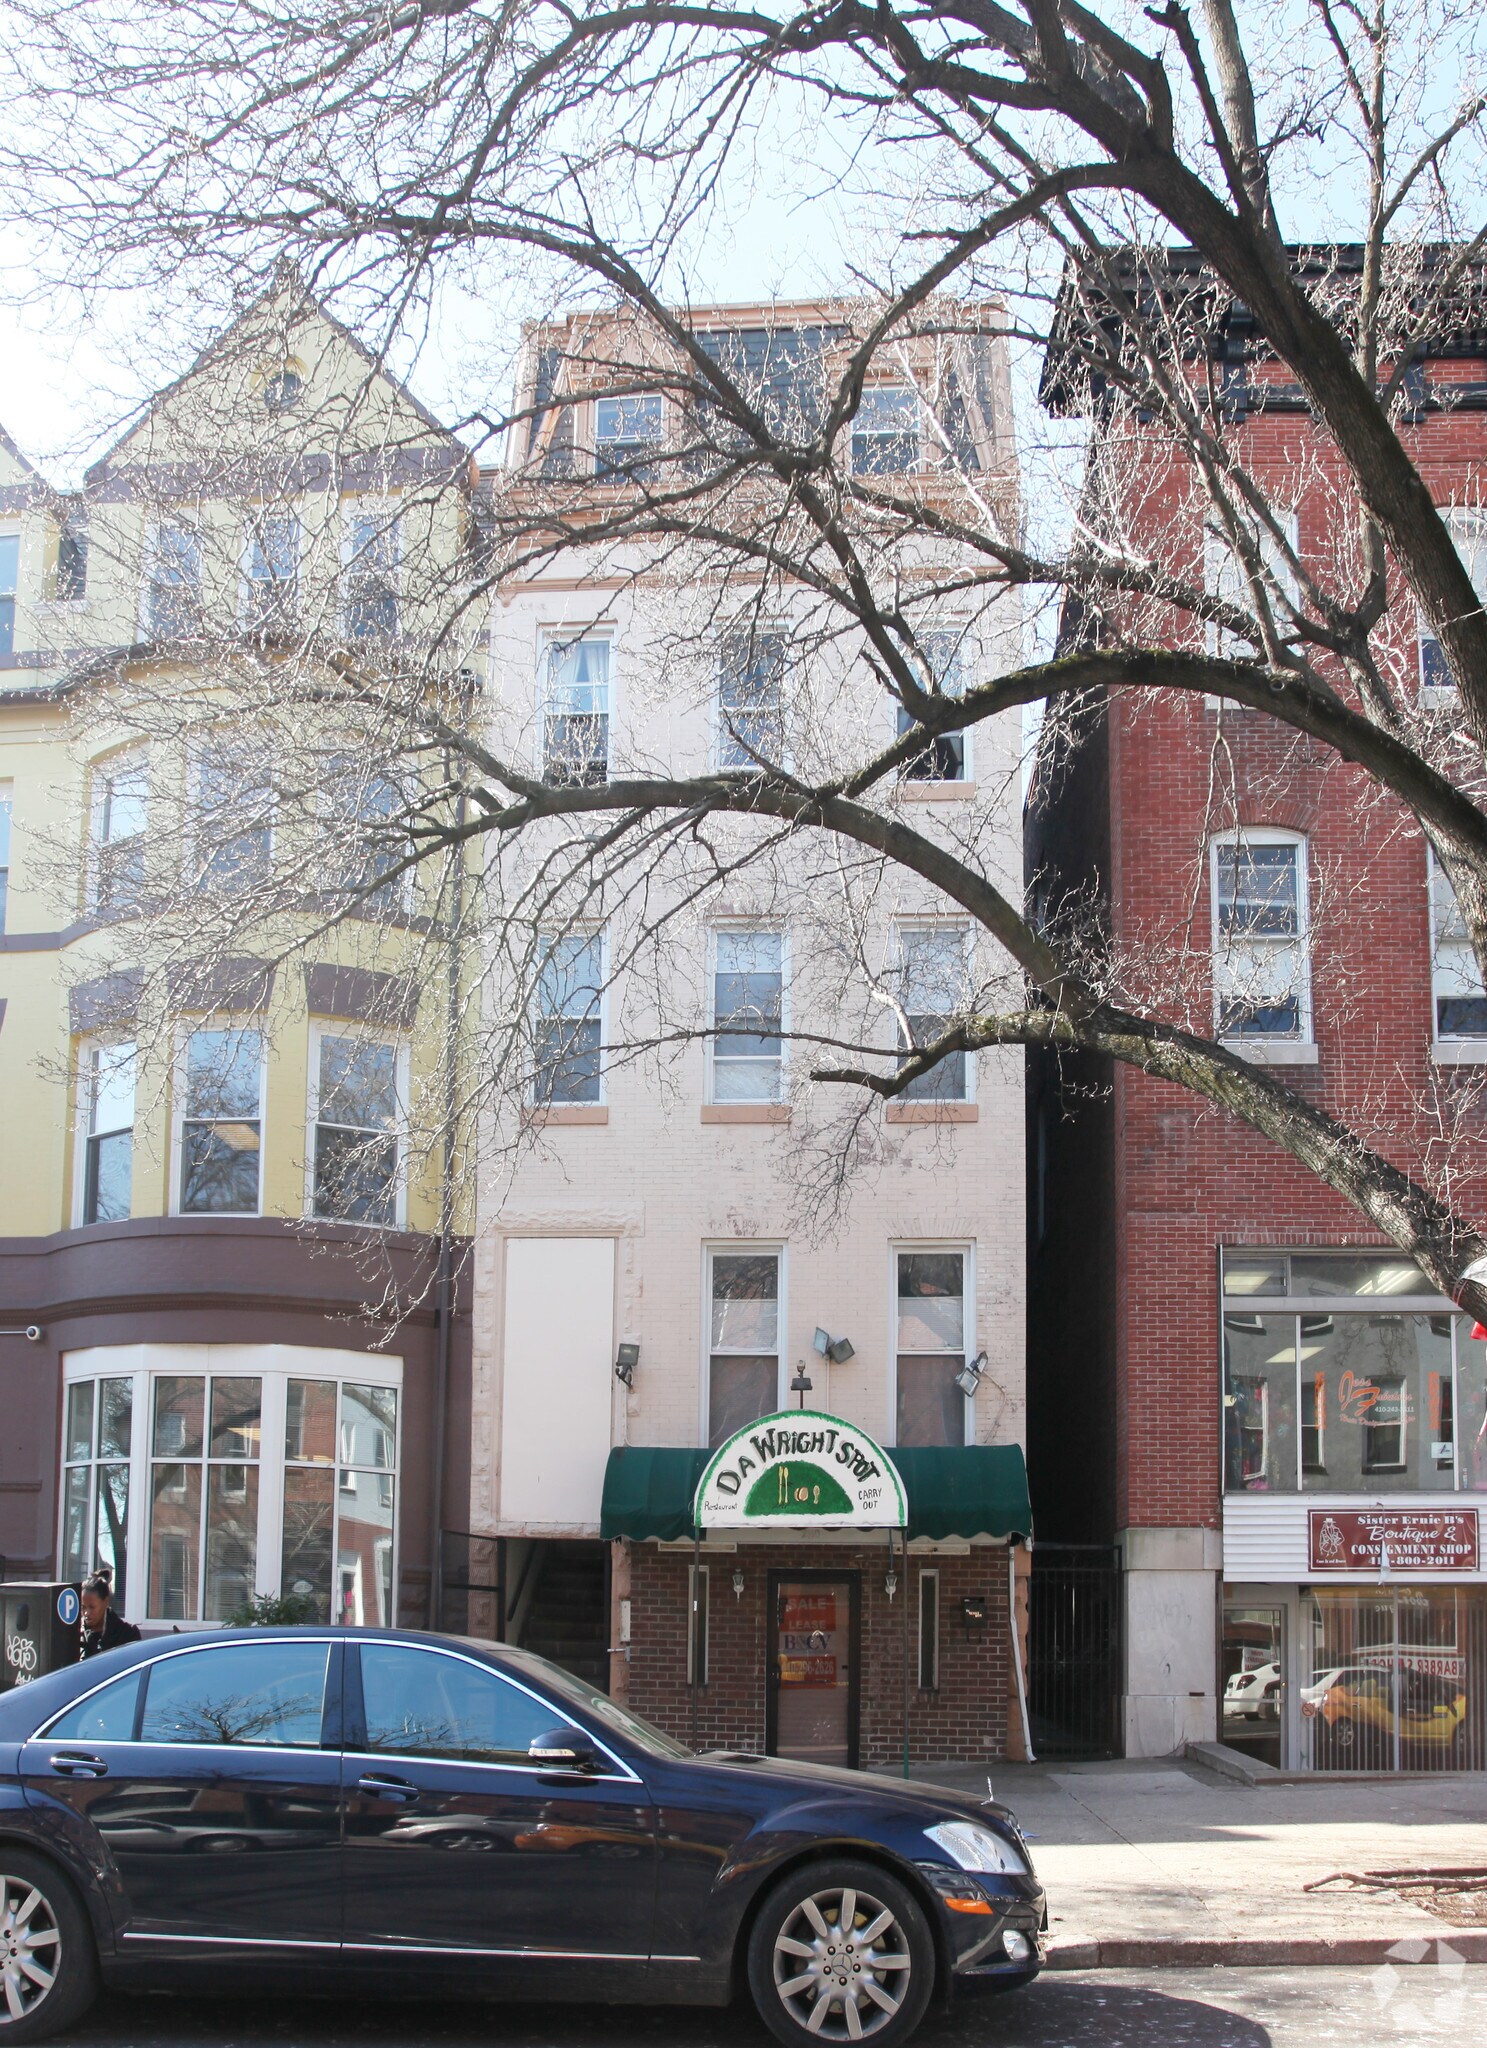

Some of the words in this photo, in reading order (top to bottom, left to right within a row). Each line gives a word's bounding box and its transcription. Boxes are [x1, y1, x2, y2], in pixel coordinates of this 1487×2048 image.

[716, 1456, 756, 1495] DA
[835, 1441, 881, 1483] SPOT
[858, 1488, 882, 1501] CARRY
[704, 1501, 738, 1511] Restaurant
[862, 1501, 878, 1510] OUT
[1357, 1515, 1399, 1525] Sister
[1402, 1514, 1441, 1525] Ernie
[1444, 1515, 1464, 1525] B's
[1365, 1525, 1440, 1543] Boutique
[1443, 1525, 1457, 1542] &
[1351, 1544, 1437, 1555] CONSGNMENT
[1440, 1544, 1472, 1555] SHOP
[1368, 1556, 1455, 1565] 41-800-2011
[65, 1595, 75, 1619] P
[787, 1599, 827, 1610] SALE
[788, 1621, 826, 1630] LEASE
